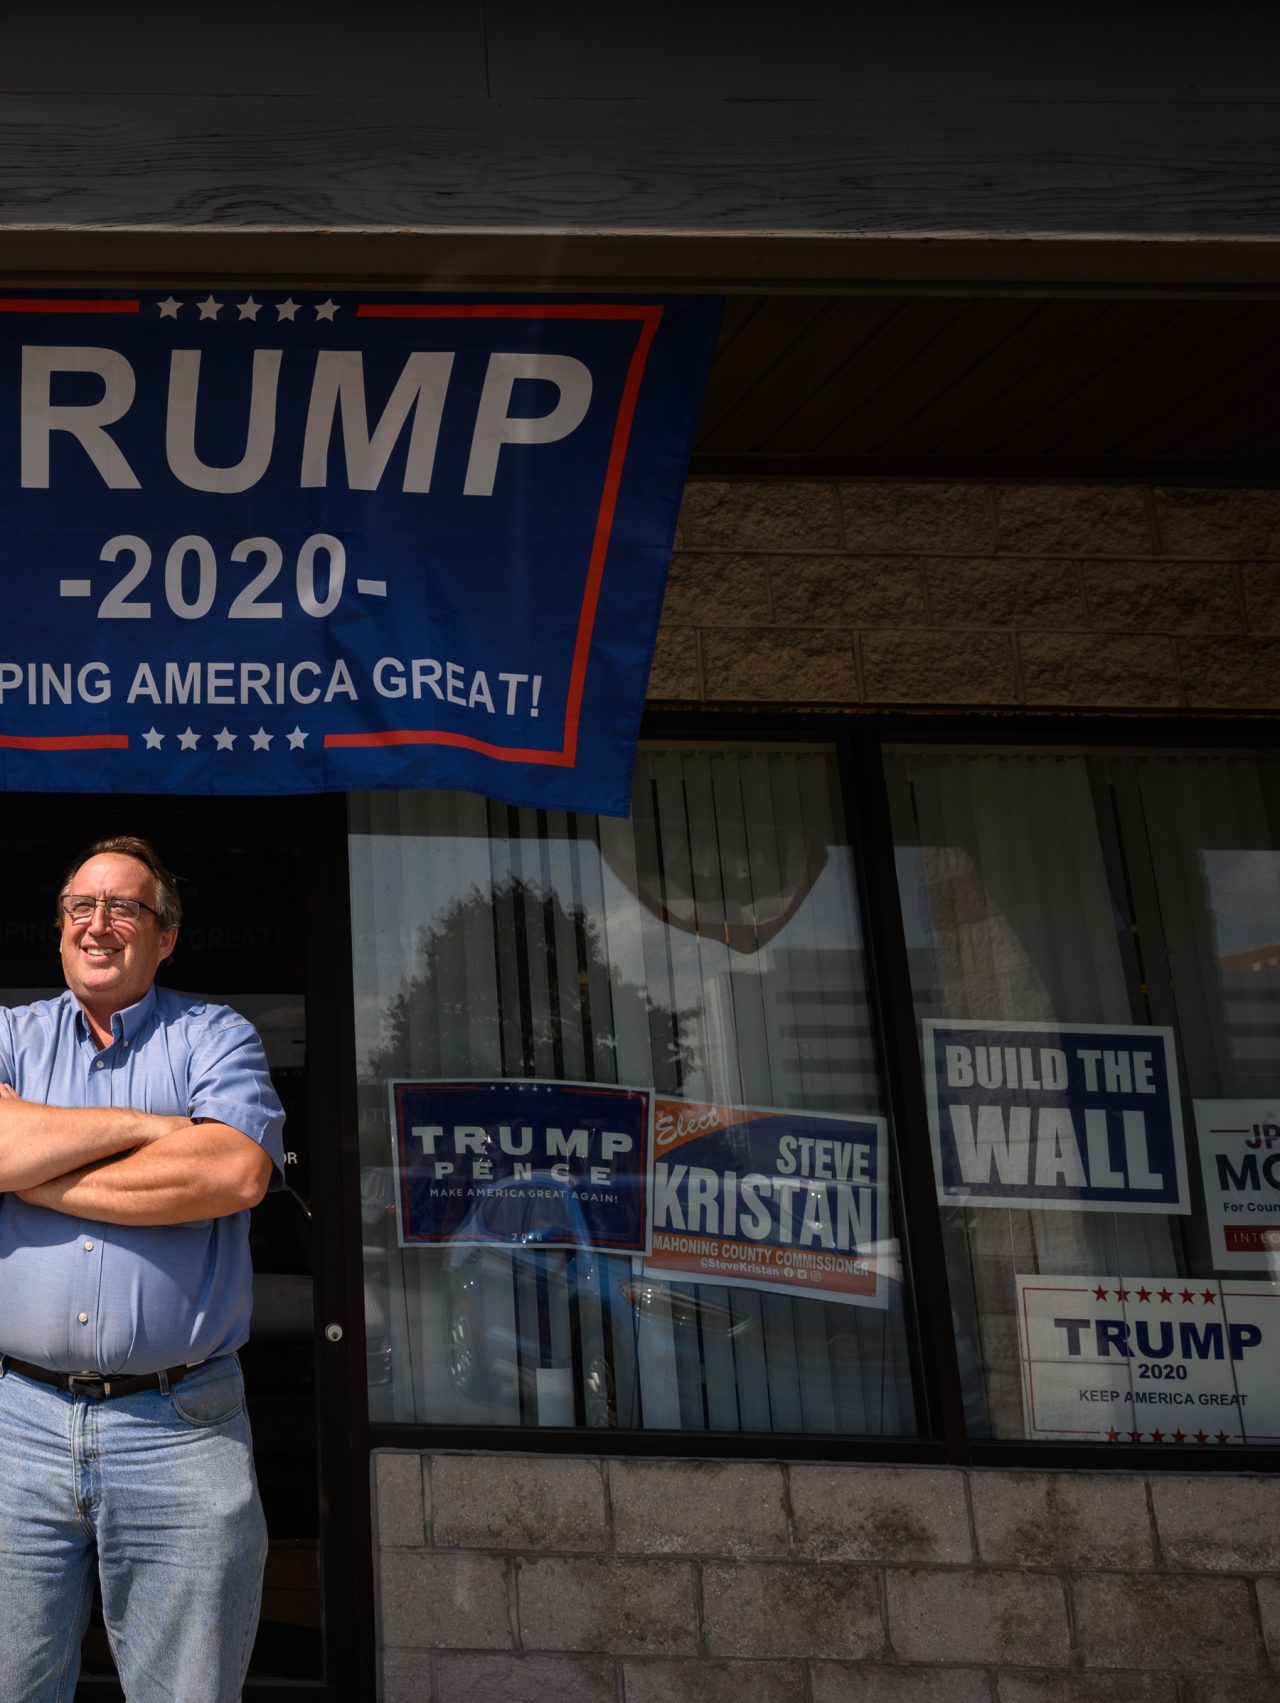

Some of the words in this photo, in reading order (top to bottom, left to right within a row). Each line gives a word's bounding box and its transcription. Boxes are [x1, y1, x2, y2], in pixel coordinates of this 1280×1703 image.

[60, 534, 387, 619] -2020-
[128, 659, 358, 705] AMERICA
[373, 657, 541, 718] GREAT!
[946, 1045, 1068, 1091] BUILD
[1077, 1050, 1156, 1094] THE
[412, 1126, 633, 1160] TRUMP
[656, 1107, 720, 1146] Elect
[776, 1135, 870, 1184] STEVE
[949, 1104, 1163, 1190] WALL
[435, 1161, 611, 1185] PENCE
[430, 1188, 463, 1198] MAKE
[467, 1188, 525, 1198] AMERICA
[529, 1189, 566, 1199] GREAT
[571, 1192, 618, 1204] AGAIN!
[654, 1162, 872, 1253] KRISTAN
[1224, 1202, 1244, 1212] For
[652, 1235, 718, 1256] MAHONING
[722, 1243, 772, 1263] COUNTY
[775, 1250, 870, 1276] COMMISSIONER
[700, 1258, 779, 1276] @SteveKristan
[1054, 1318, 1262, 1360] TRUMP
[1138, 1364, 1187, 1380] 2020
[1079, 1390, 1119, 1402] KEEP
[1124, 1391, 1194, 1405] AMERICA
[1199, 1394, 1248, 1406] GREAT
